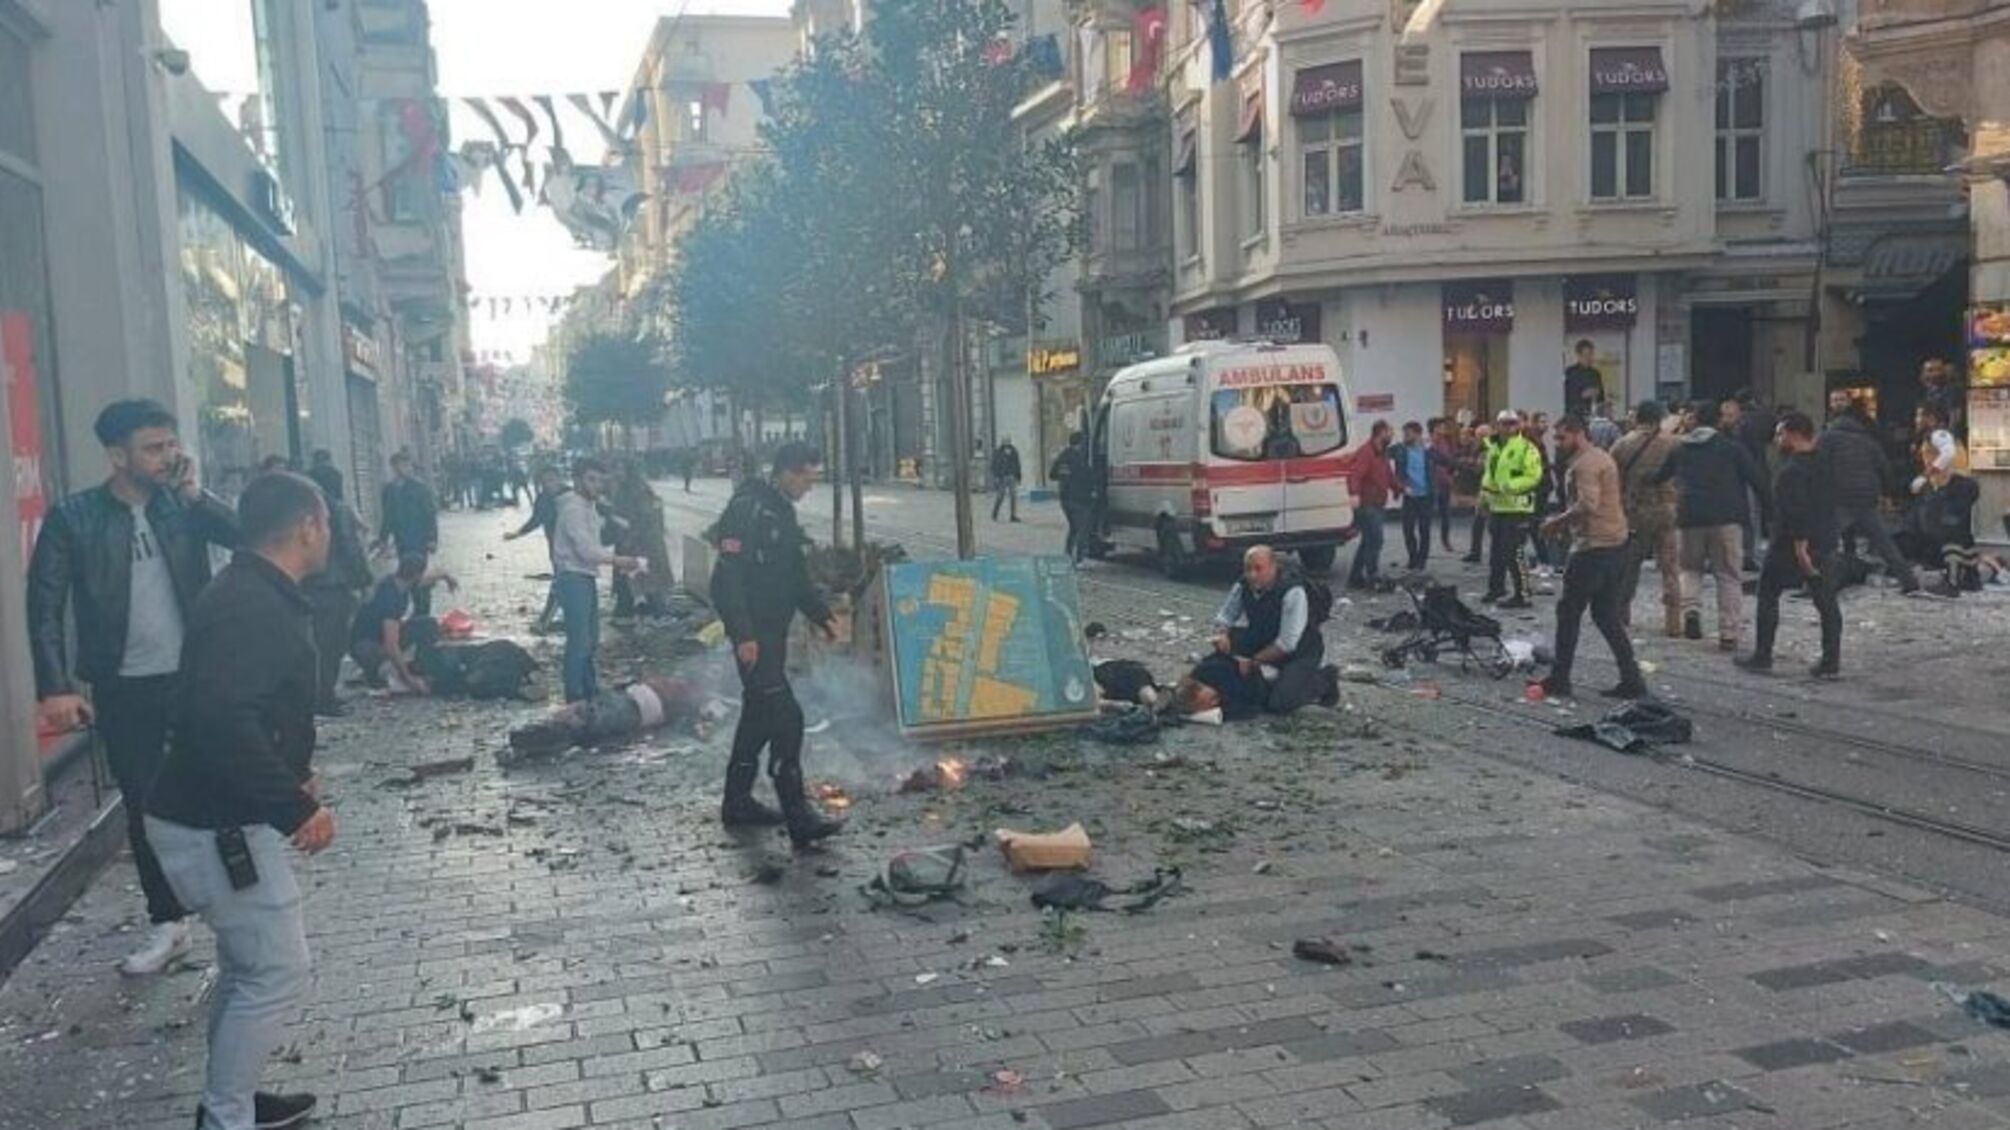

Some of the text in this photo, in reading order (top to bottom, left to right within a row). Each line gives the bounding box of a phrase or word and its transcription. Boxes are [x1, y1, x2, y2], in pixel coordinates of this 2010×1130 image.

[1464, 76, 1536, 89] TUDORS
[1594, 71, 1667, 85] TUDORS
[1296, 84, 1360, 107] TUDORS
[1448, 303, 1515, 321] TUDORS
[1570, 298, 1637, 315] TUDORS
[1219, 366, 1326, 385] AMBULANS
